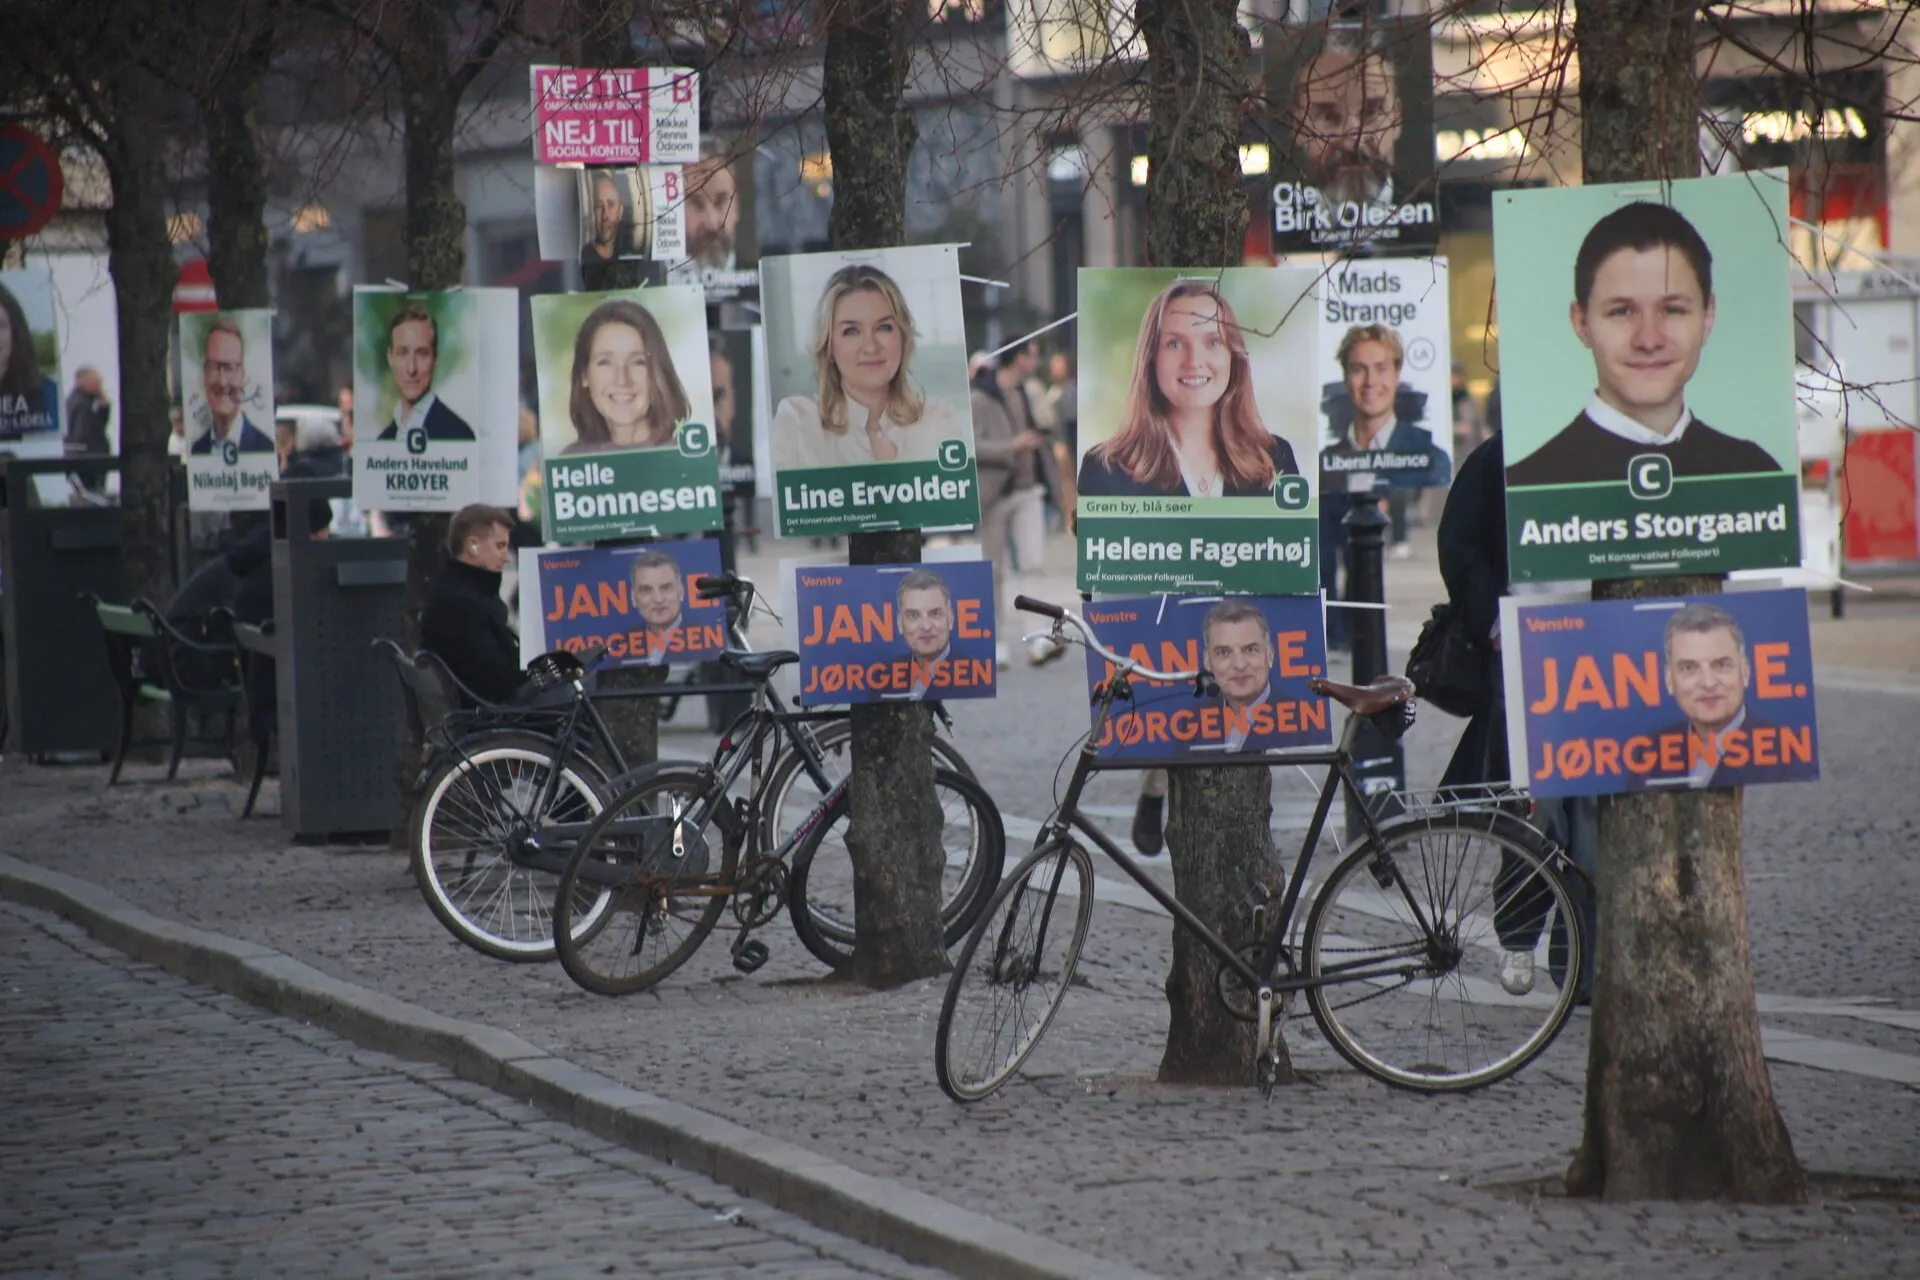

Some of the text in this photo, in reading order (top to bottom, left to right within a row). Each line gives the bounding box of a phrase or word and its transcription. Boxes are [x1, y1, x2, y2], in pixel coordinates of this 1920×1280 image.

[542, 74, 641, 99] NEJ TIL
[673, 74, 692, 103] B
[545, 119, 641, 144] NEJ TIL
[656, 118, 688, 128] Mikkel
[656, 129, 688, 139] Senna
[547, 145, 640, 158] SOCIAL KONTROL
[656, 140, 693, 150] Odoom
[664, 172, 679, 200] B
[1273, 182, 1318, 205] Ole
[1275, 201, 1434, 232] Birk Olesen
[1338, 270, 1401, 293] Mads
[1326, 301, 1417, 326] Strange
[411, 431, 422, 448] C
[686, 428, 702, 450] C
[367, 457, 467, 471] Anders Havelund
[945, 445, 960, 465] C
[1323, 453, 1429, 471] Liberal Alliance
[193, 471, 237, 493] Nikolaj
[387, 473, 449, 491] KRØYER
[551, 463, 615, 489] Helle
[1638, 463, 1661, 490] C
[554, 483, 718, 521] Bonnesen
[784, 475, 971, 511] Line Ervolder
[1283, 482, 1301, 504] C
[1086, 500, 1193, 514] Grøn by, blå søer
[1520, 504, 1787, 546] Anders Storgaard
[1086, 536, 1311, 568] Helene Fagerhøj
[1589, 547, 1720, 563] Det Konservative Folkeparti
[802, 576, 842, 587] Venstre
[1086, 572, 1194, 583] Det Konservative Folkeparti
[547, 573, 720, 622] JAN E.
[803, 599, 992, 645] JAN E.
[1090, 611, 1137, 624] Venstre
[1526, 616, 1585, 632] Venstre
[1093, 630, 1322, 692] JAN E.
[804, 659, 992, 693] JØRGENSEN
[1530, 641, 1808, 715] JAN E.
[1099, 700, 1327, 747] JØRGENSEN
[1534, 726, 1812, 780] JØRGENSEN
